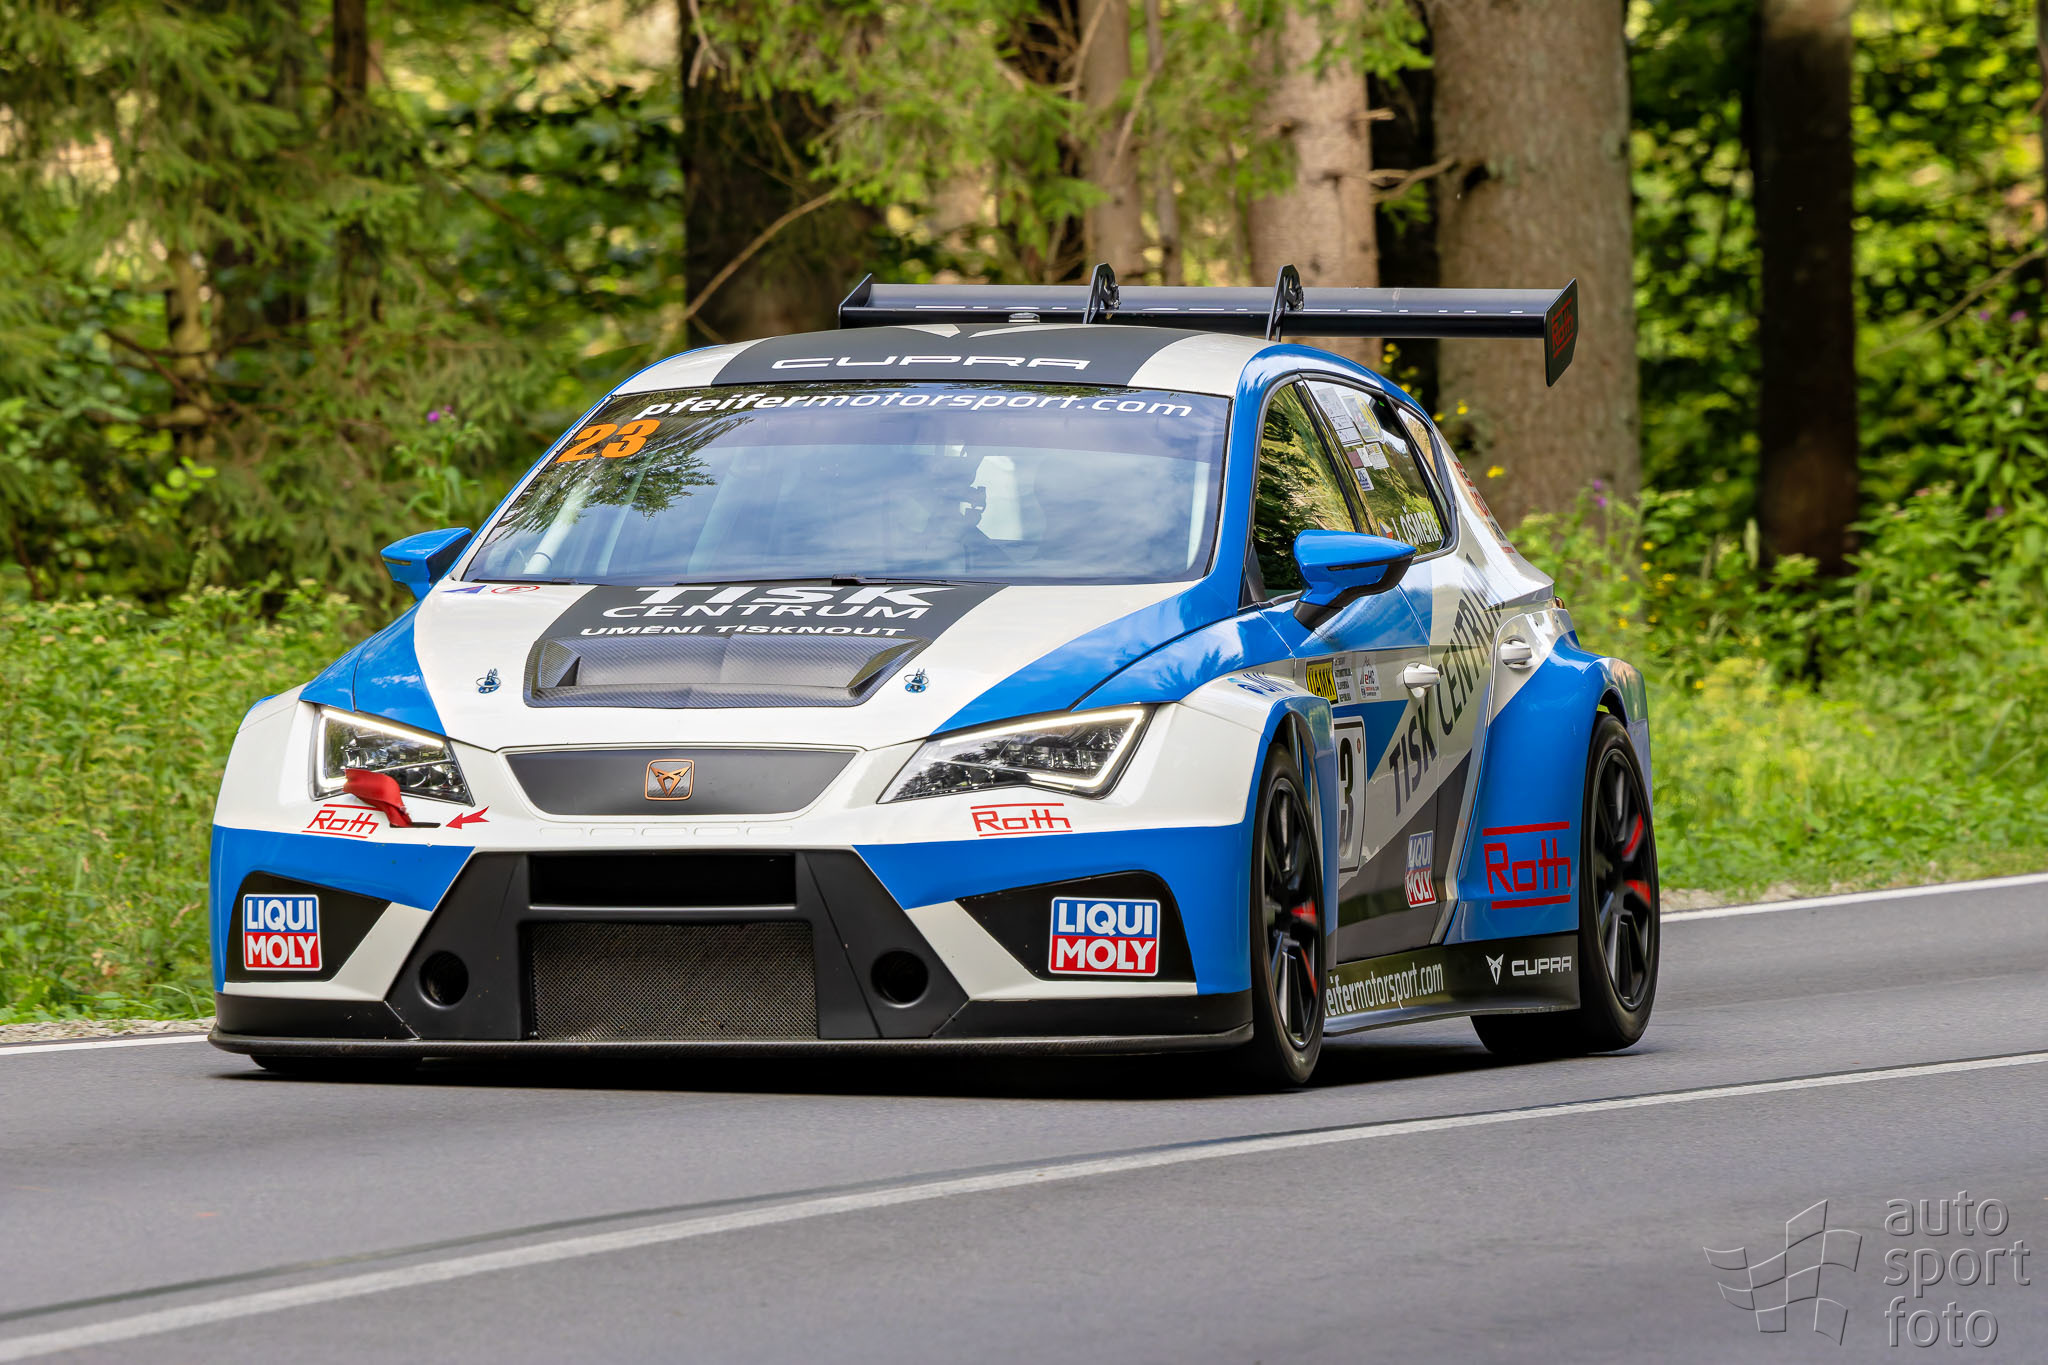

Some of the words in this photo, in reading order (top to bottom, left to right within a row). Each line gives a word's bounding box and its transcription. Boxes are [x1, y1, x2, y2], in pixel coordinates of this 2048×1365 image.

[772, 355, 1091, 370] CUPRA
[632, 392, 1193, 421] pfeifermotorsport.com
[556, 419, 661, 464] 23
[602, 604, 930, 619] CENTRUM
[635, 586, 957, 606] TISK
[714, 625, 906, 636] TISKNOUT
[1388, 692, 1438, 817] TISK
[1338, 737, 1354, 857] 3
[306, 809, 379, 834] Roth
[971, 809, 1072, 831] Roth
[1408, 836, 1433, 868] LIQUI
[1483, 838, 1571, 894] Roth
[1406, 870, 1433, 902] MOLY
[247, 899, 314, 932] LIQUI
[1058, 902, 1153, 937] LIQUI
[247, 934, 317, 966] MOLY
[1055, 938, 1156, 971] MOLY
[1512, 956, 1572, 976] CUPRA
[1325, 962, 1445, 1017] eifermotorsport.com
